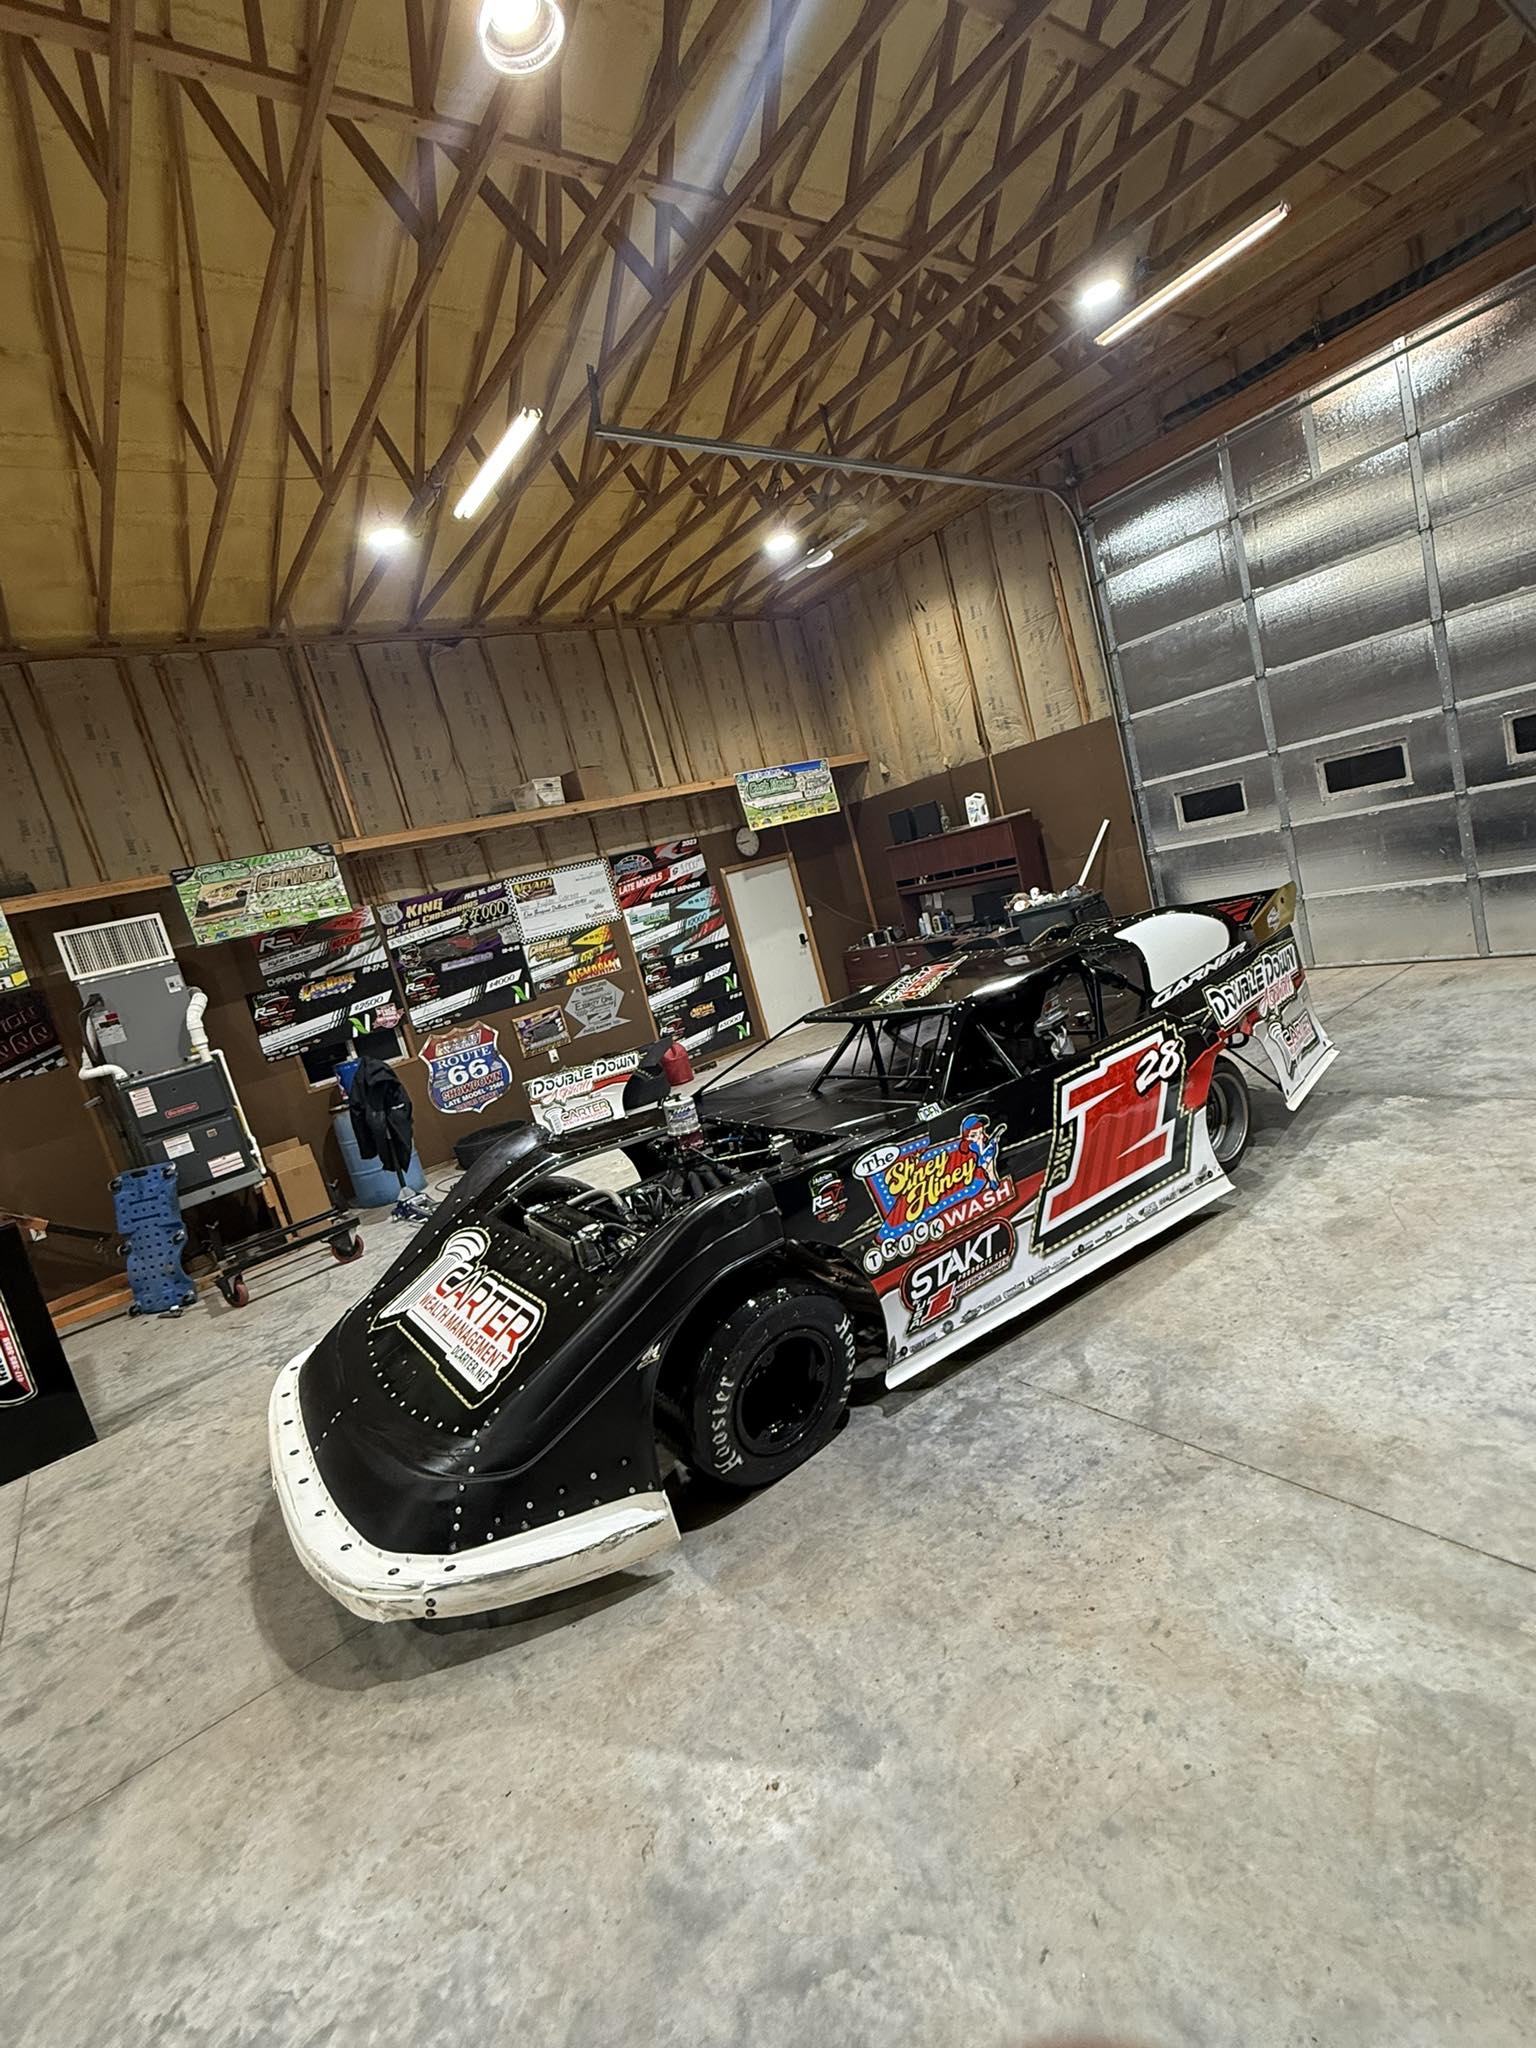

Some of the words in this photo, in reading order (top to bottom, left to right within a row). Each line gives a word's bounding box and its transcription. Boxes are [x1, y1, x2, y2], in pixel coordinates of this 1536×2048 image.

[256, 860, 335, 893] GARNER
[618, 881, 637, 896] LATE
[637, 871, 663, 891] MODELS
[651, 888, 677, 900] FEATURE
[266, 971, 306, 988] CHAMPION
[1151, 941, 1248, 1009] GARNER
[1211, 965, 1264, 1020] DOUBLE
[1265, 944, 1297, 987] DOWN
[437, 1045, 492, 1070] ROUTE
[447, 1058, 490, 1086] 66
[533, 1066, 593, 1097] DOUBLE
[594, 1054, 638, 1076] DOWN
[1135, 1038, 1182, 1094] 28
[441, 1071, 503, 1101] SHOWDOWN
[444, 1096, 461, 1109] LATE
[461, 1090, 484, 1105] MODEL
[561, 1101, 609, 1122] CARTER
[1039, 1030, 1177, 1237] 1
[862, 1152, 895, 1175] The
[905, 1158, 977, 1222] Hiney
[866, 1222, 945, 1272] TRUCK
[944, 1181, 1012, 1228] WASH
[910, 1223, 1001, 1301] STAKT
[957, 1255, 996, 1281] PRODUCTS
[434, 1266, 536, 1354] CARTER
[418, 1292, 452, 1326] WEALTH
[445, 1311, 509, 1373] MANAGEMENT
[450, 1344, 493, 1387] DCARTER.NET
[711, 1375, 744, 1475] Hoosier
